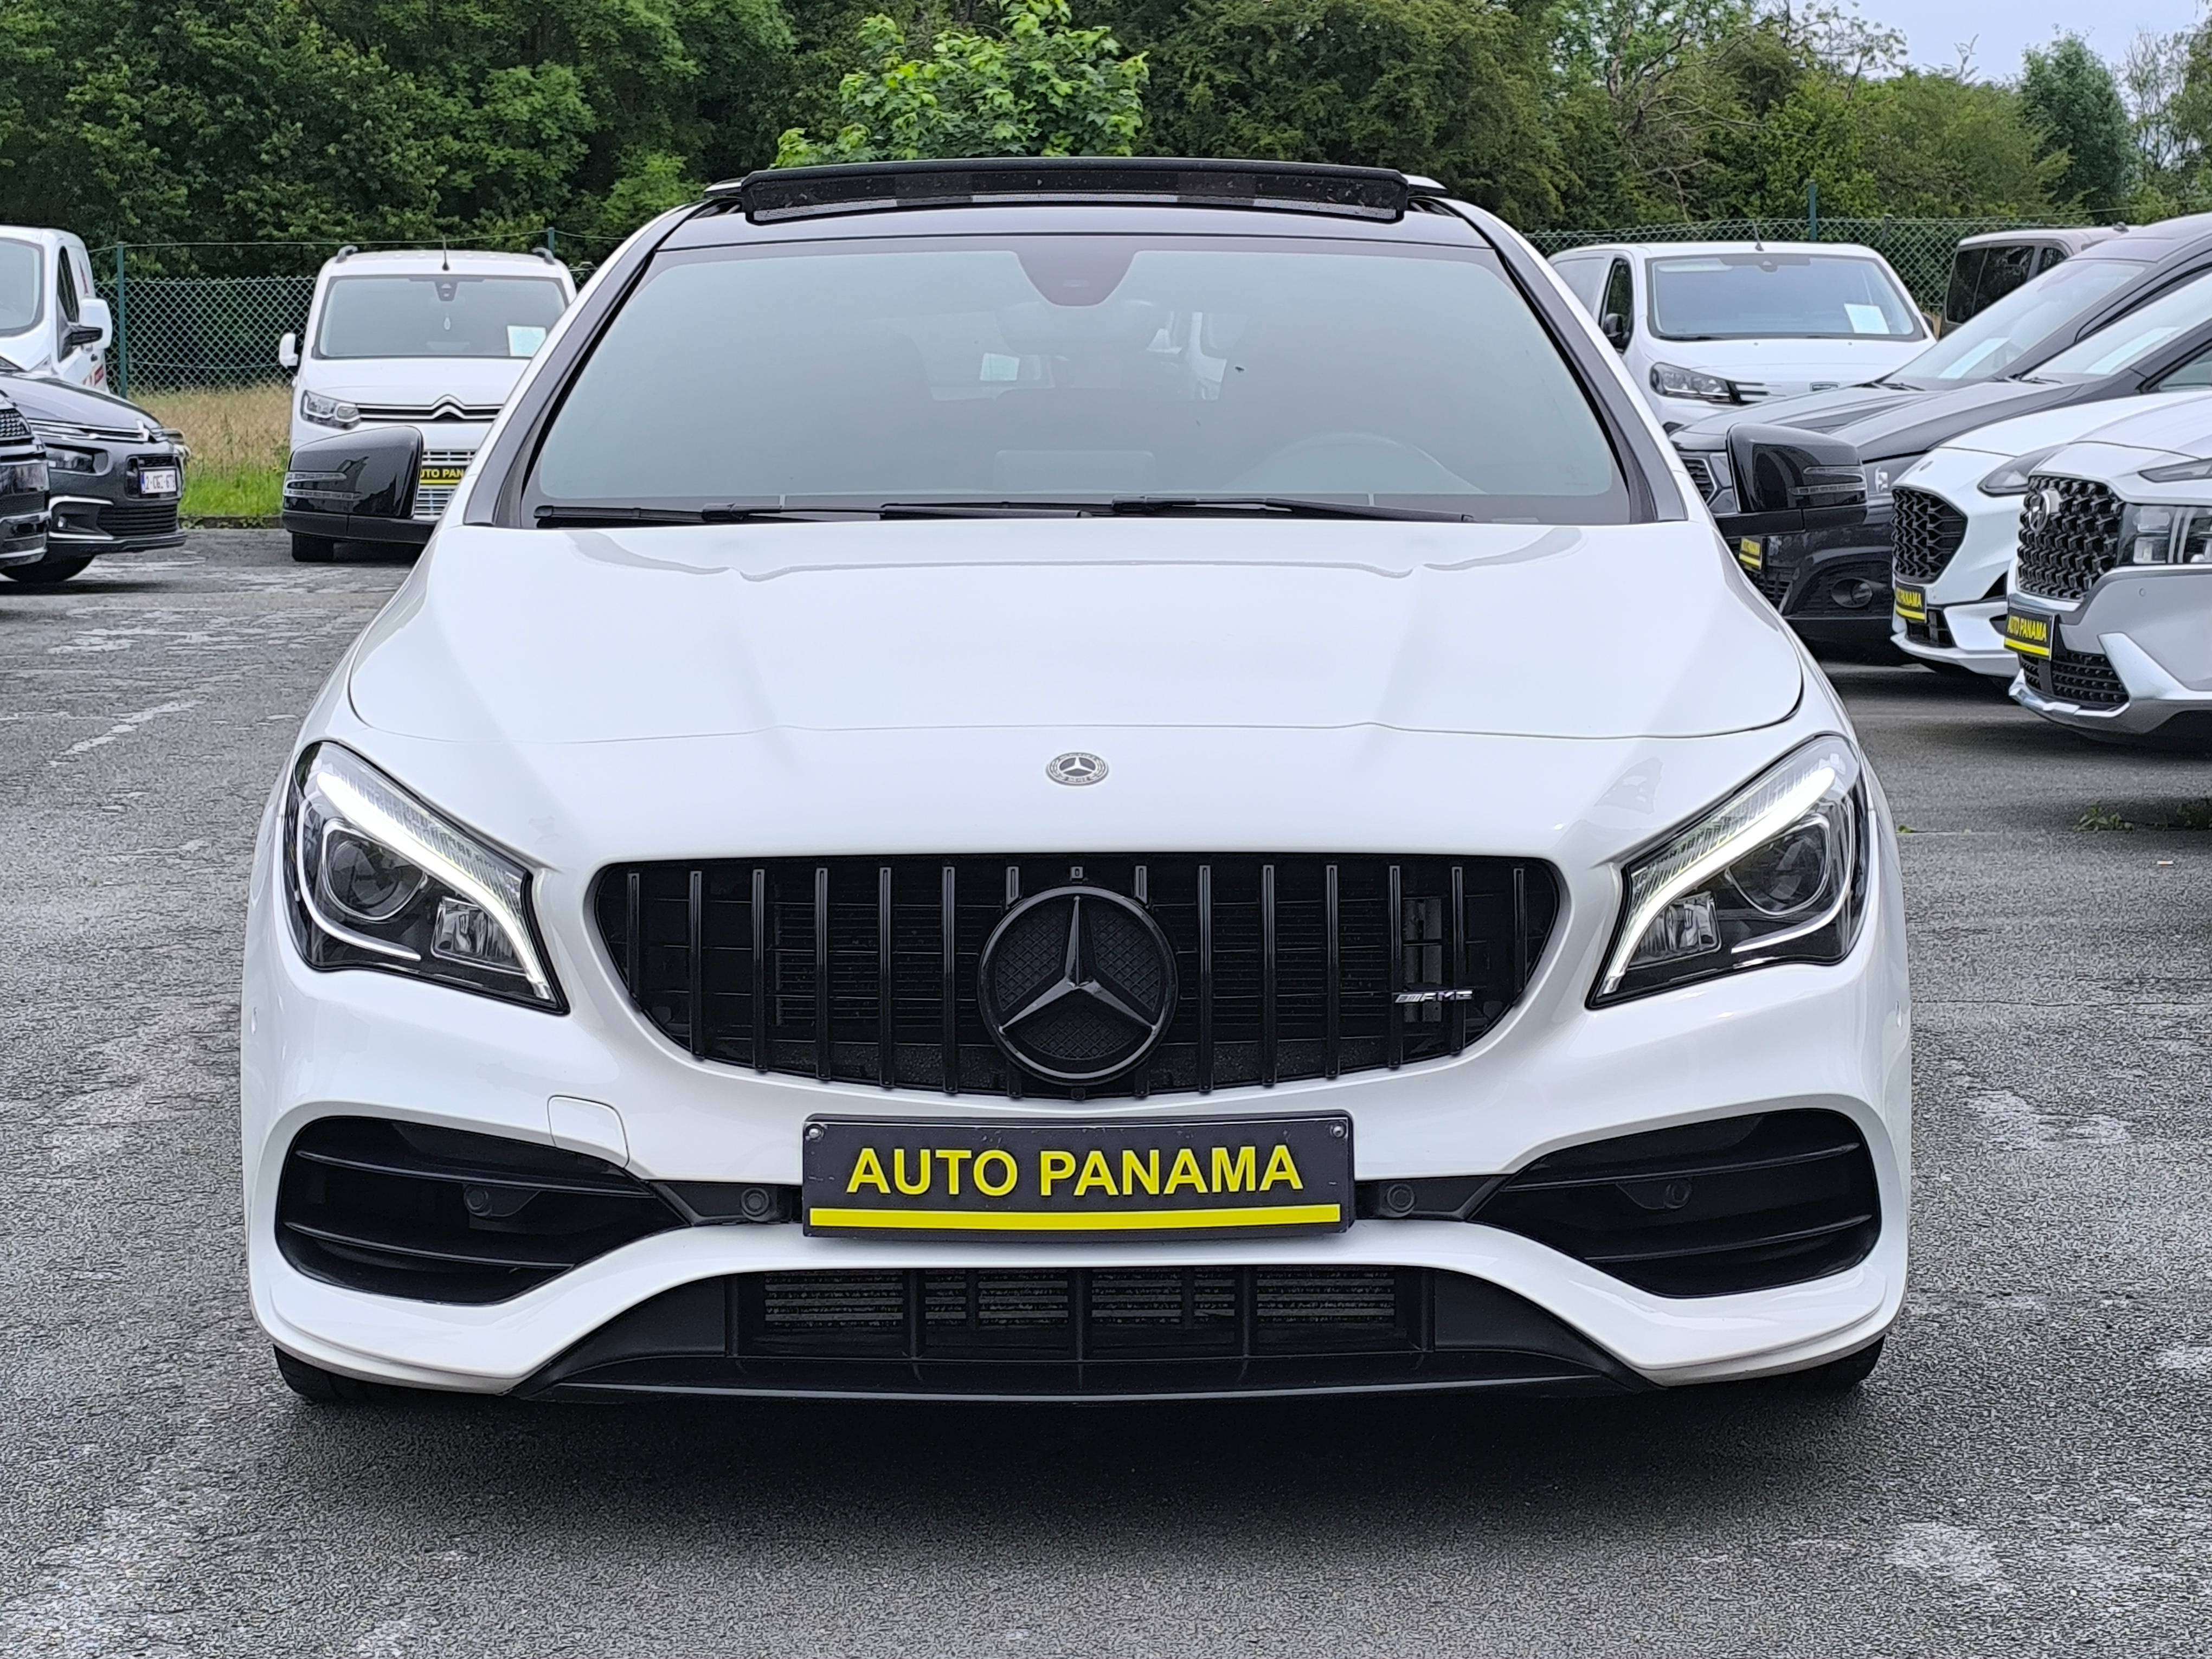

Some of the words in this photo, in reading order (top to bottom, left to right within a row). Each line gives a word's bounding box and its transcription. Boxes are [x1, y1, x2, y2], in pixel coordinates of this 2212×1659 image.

[420, 468, 440, 478] UTO
[442, 468, 464, 478] PAN
[2019, 618, 2047, 642] PANAMA
[847, 1148, 1019, 1197] AUTO
[1039, 1144, 1304, 1197] PANAMA
